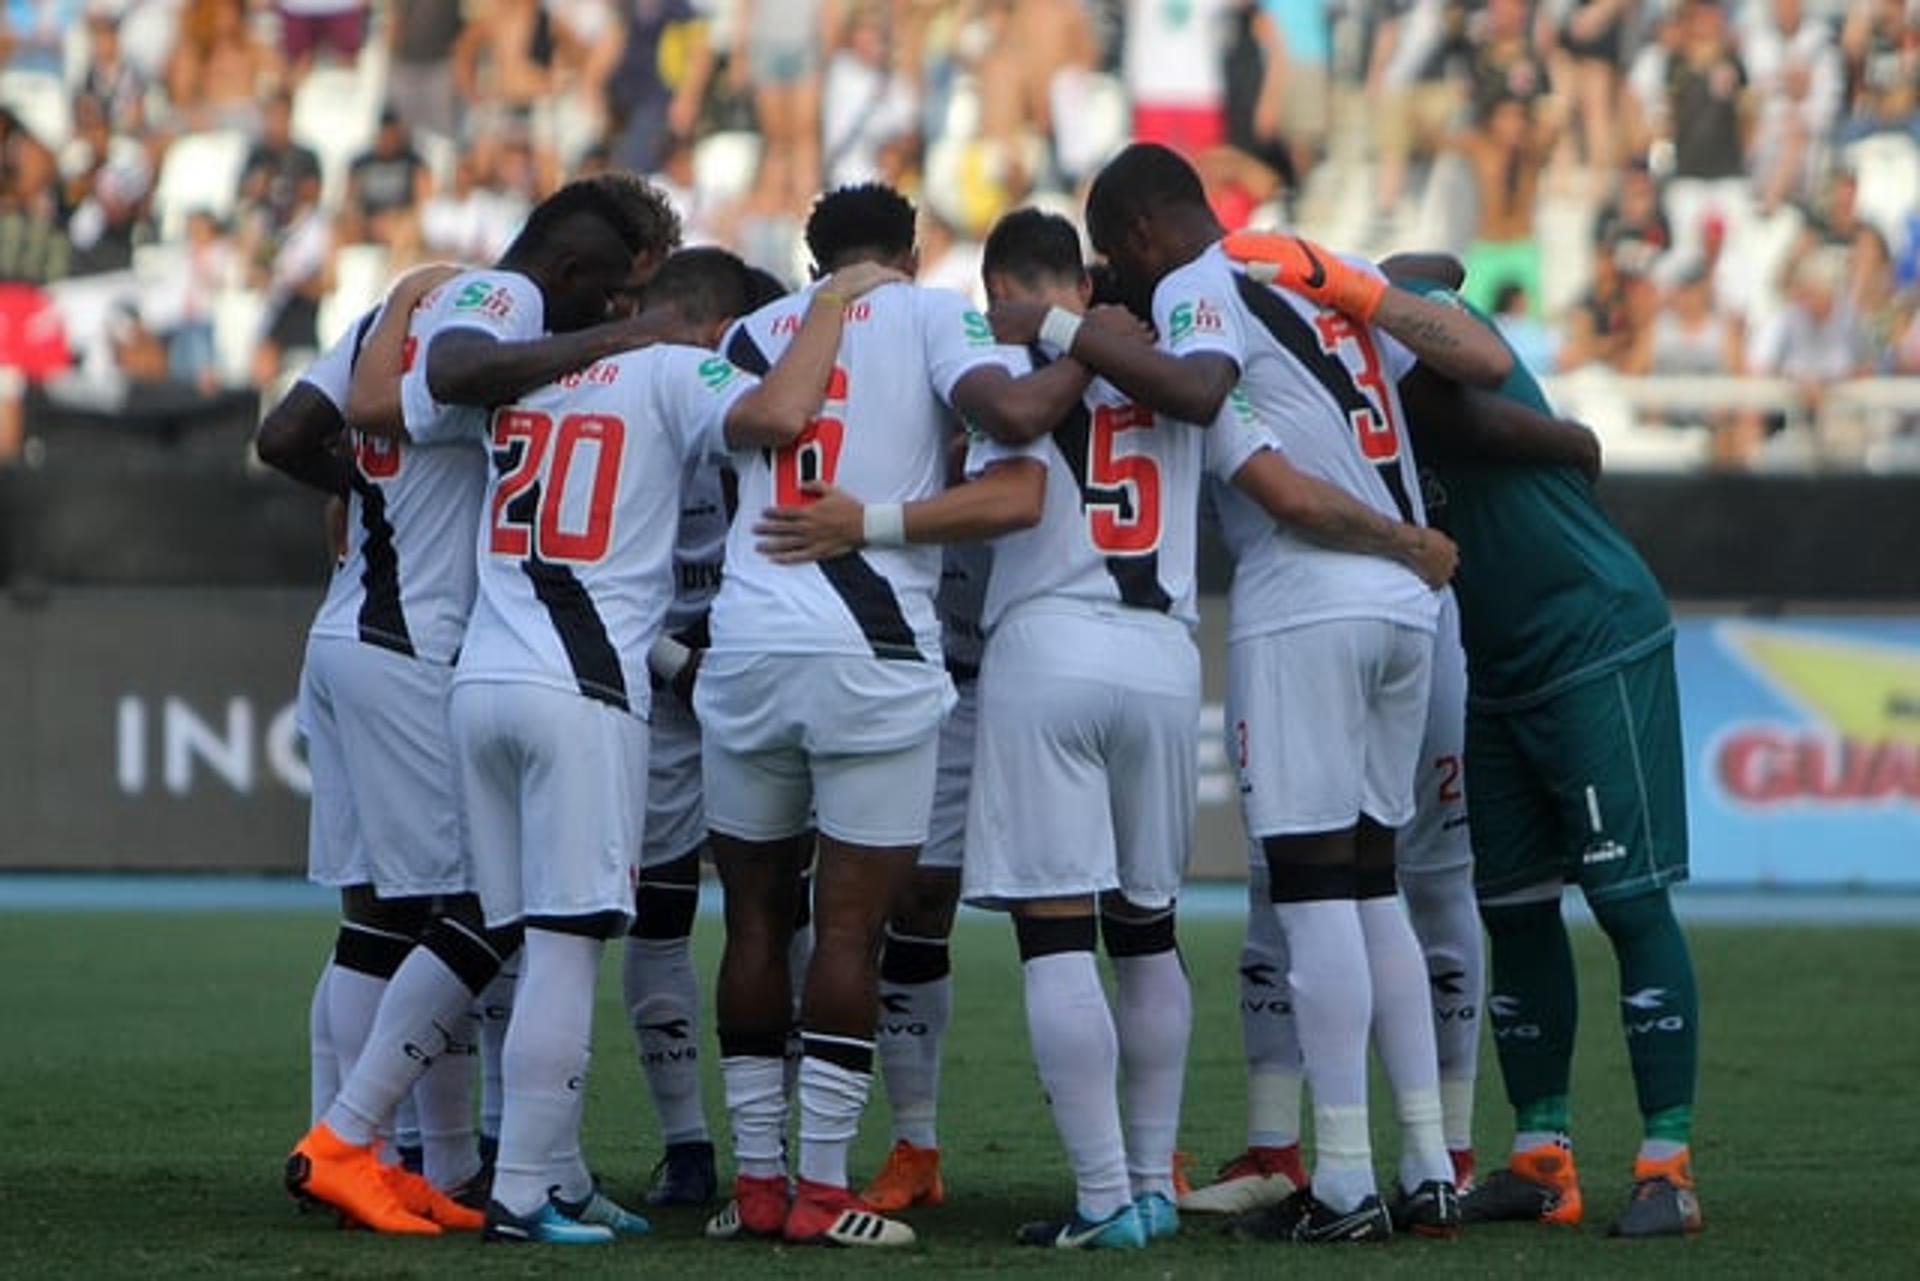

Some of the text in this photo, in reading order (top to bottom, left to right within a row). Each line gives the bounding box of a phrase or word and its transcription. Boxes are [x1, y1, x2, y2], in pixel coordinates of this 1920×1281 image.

[1312, 305, 1400, 463] 3
[488, 410, 625, 563] 20
[1086, 402, 1163, 556] 5
